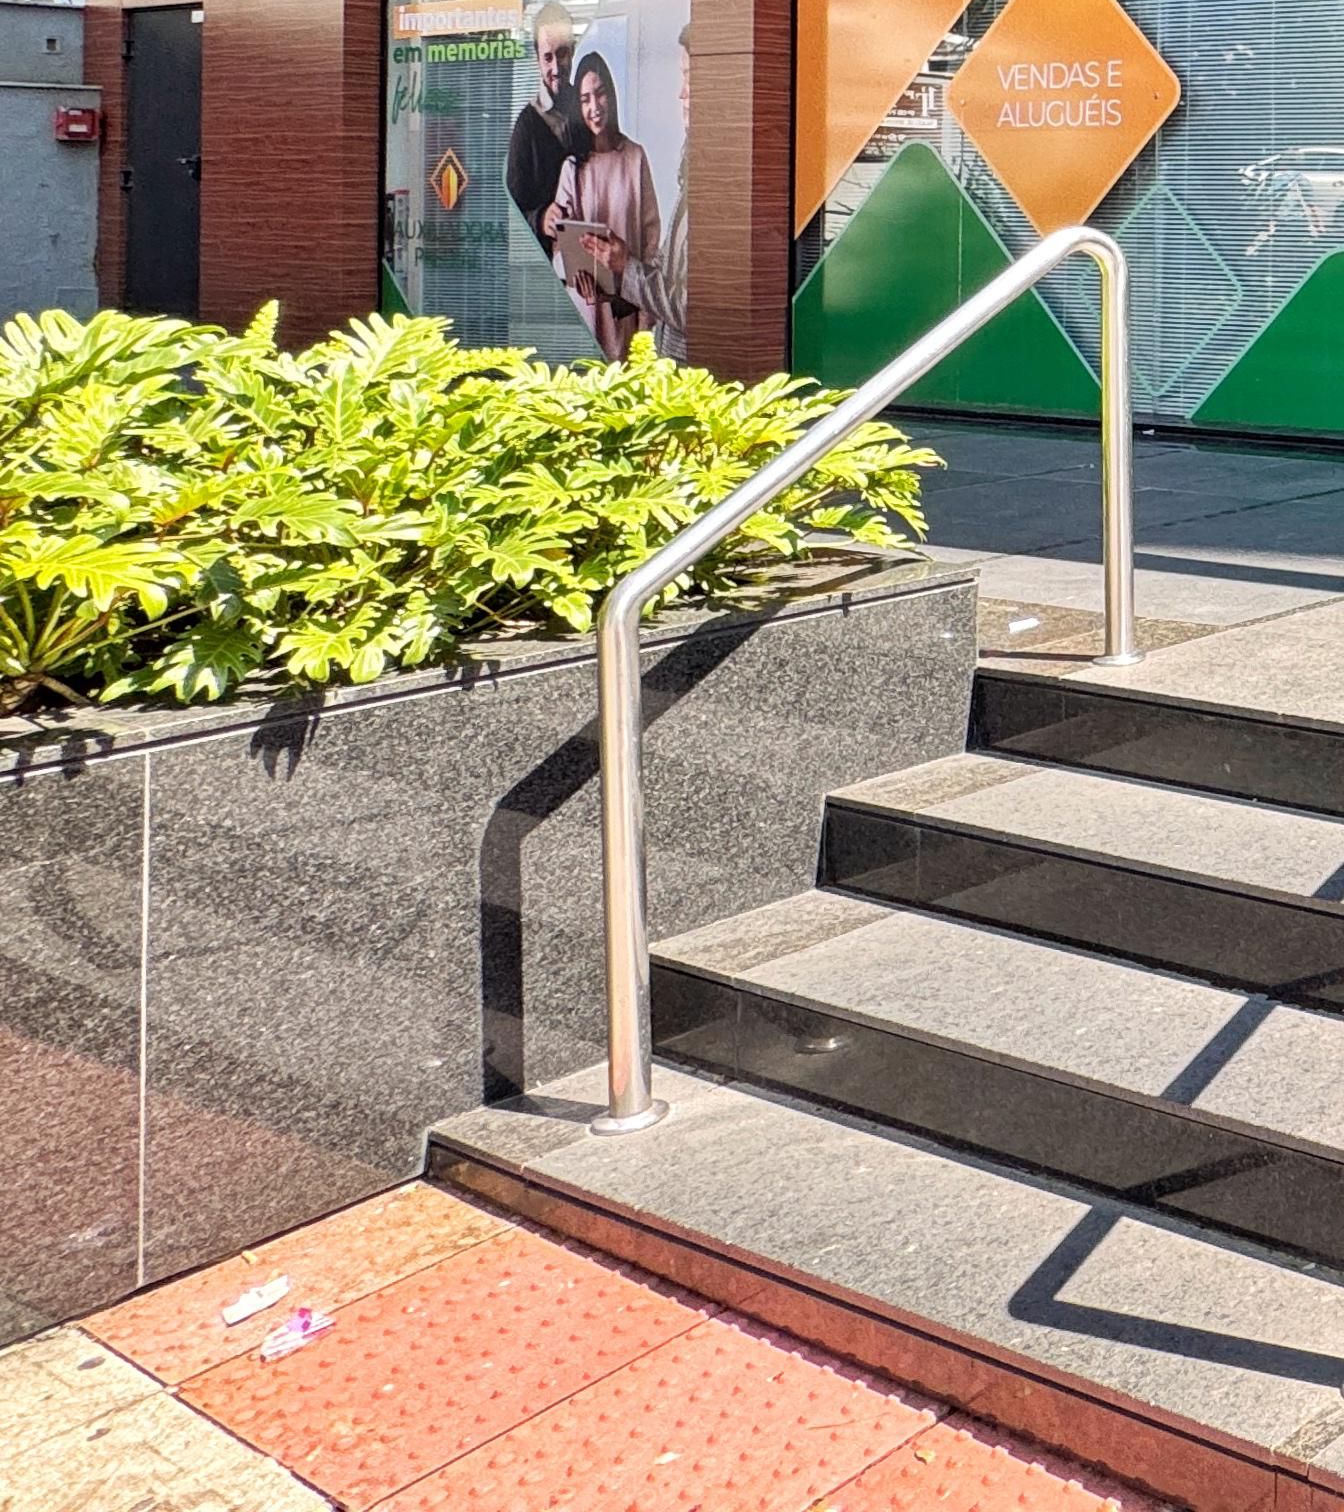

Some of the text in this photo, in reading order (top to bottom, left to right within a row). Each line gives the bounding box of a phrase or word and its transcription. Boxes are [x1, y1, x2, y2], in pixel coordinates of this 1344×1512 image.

[398, 5, 518, 33] importantes
[393, 32, 526, 64] em memórias
[995, 59, 1123, 92] VENDAS E
[995, 92, 1123, 128] ALUGUÉIS
